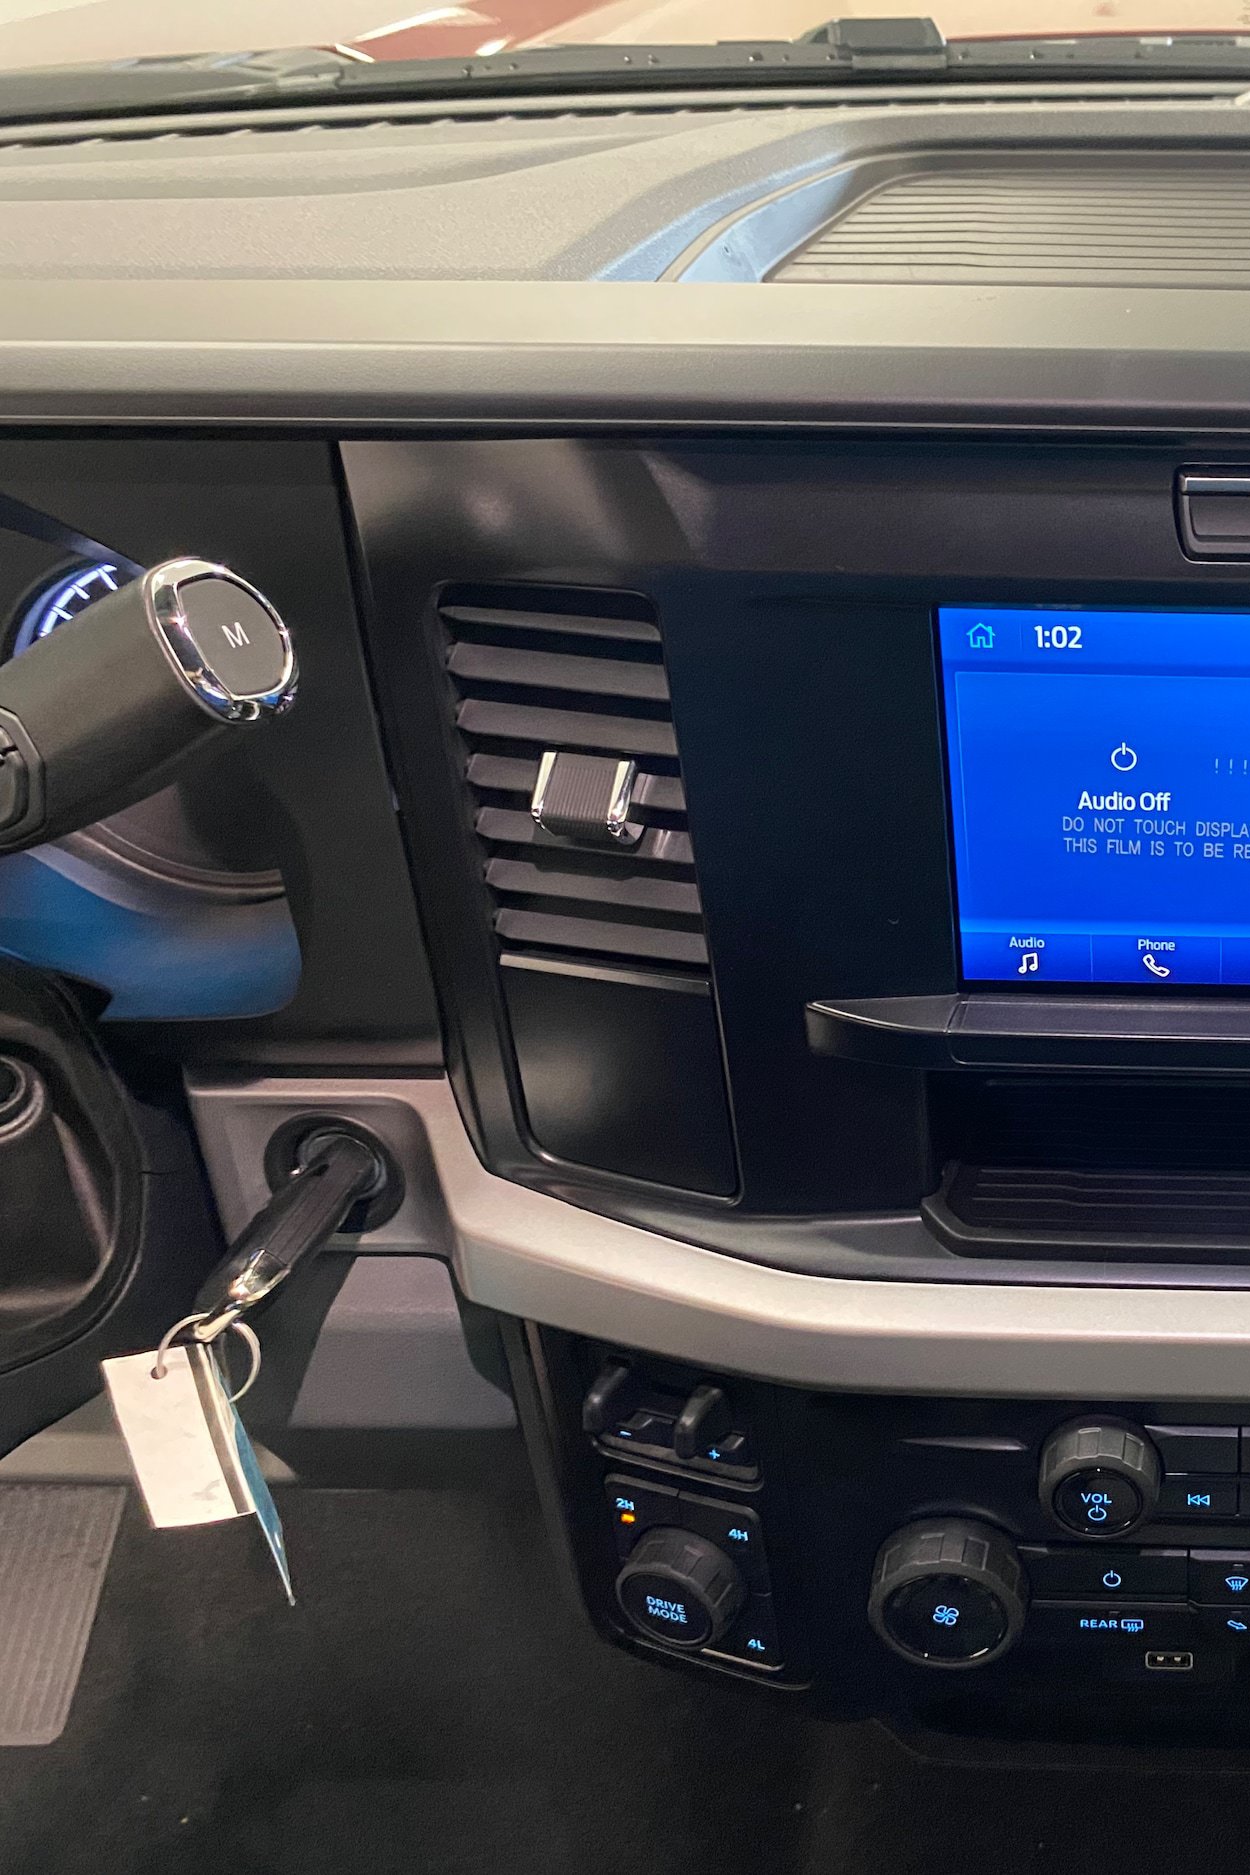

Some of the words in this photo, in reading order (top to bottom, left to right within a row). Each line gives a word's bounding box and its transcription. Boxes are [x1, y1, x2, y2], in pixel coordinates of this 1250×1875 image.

[221, 622, 250, 649] M
[1034, 626, 1083, 651] 1:02
[1078, 791, 1136, 811] Audio
[1139, 791, 1172, 811] Off
[1062, 816, 1085, 832] DO
[1094, 818, 1125, 834] NOT
[1134, 819, 1186, 836] TOUCH
[1063, 837, 1097, 854] THIS
[1106, 839, 1141, 855] FILM
[1150, 841, 1165, 856] IS
[1174, 841, 1194, 857] TO
[1203, 843, 1225, 859] BE
[1009, 936, 1045, 949] Audio
[1137, 938, 1175, 951] Phone
[616, 1498, 635, 1511] 2H
[1081, 1493, 1113, 1505] VOL
[728, 1528, 749, 1542] 4H
[646, 1595, 686, 1614] DRIVE
[648, 1605, 688, 1623] MODE
[1080, 1618, 1118, 1629] REAR
[747, 1639, 766, 1651] 4L
